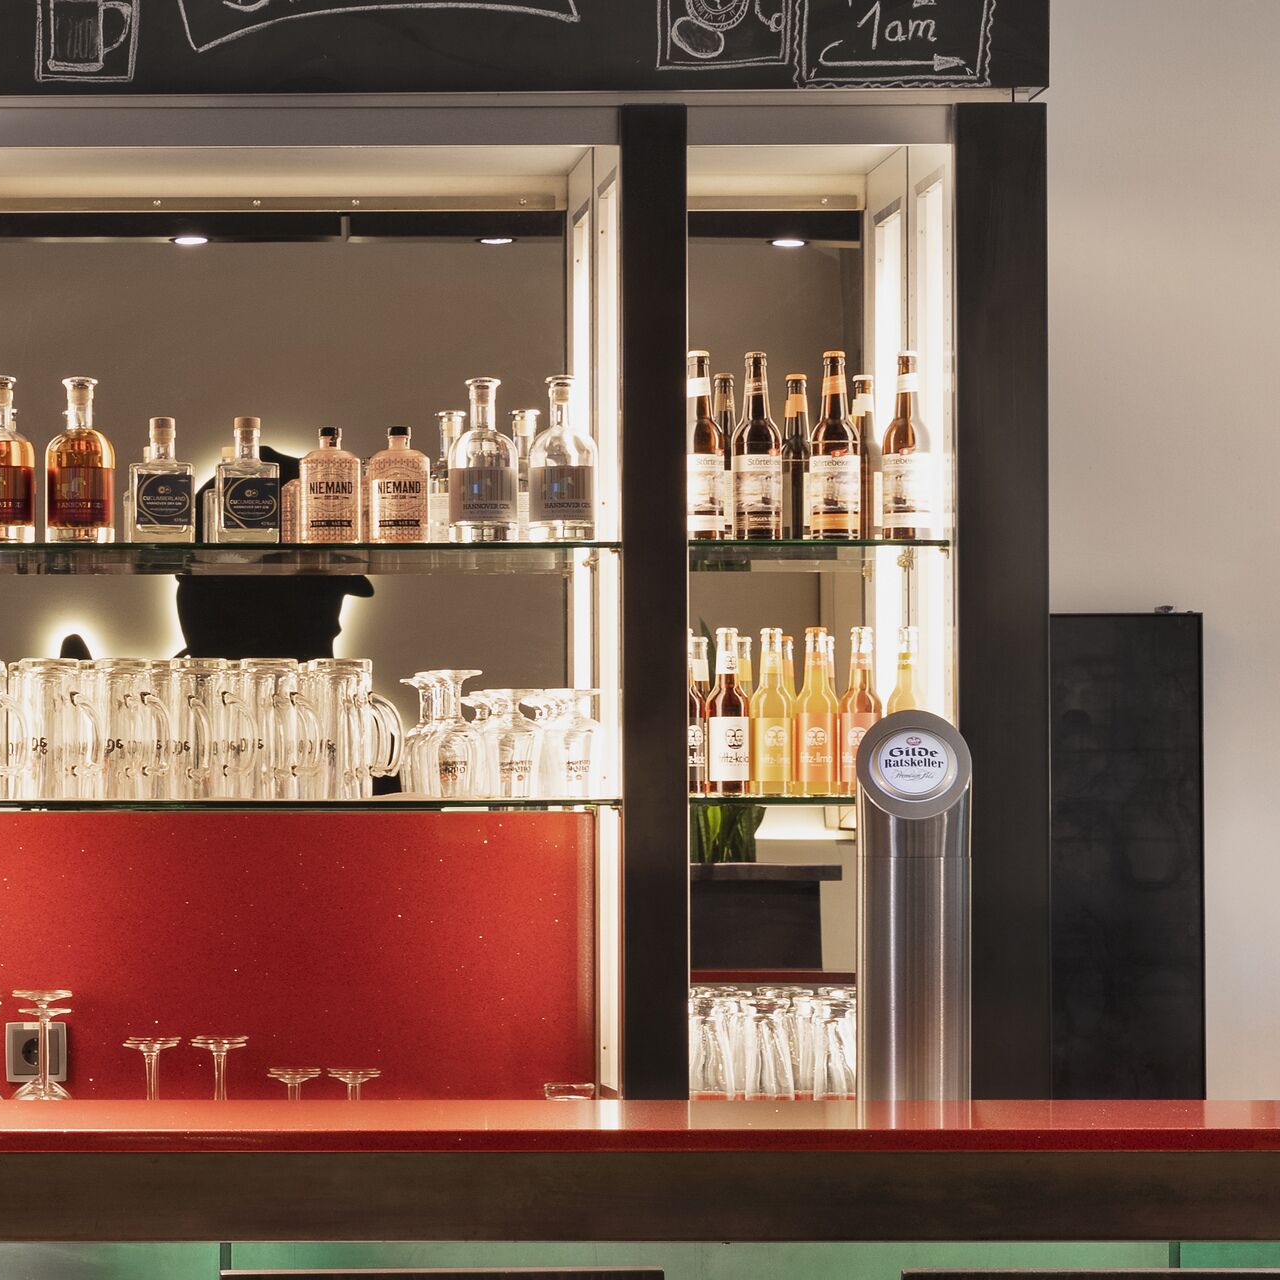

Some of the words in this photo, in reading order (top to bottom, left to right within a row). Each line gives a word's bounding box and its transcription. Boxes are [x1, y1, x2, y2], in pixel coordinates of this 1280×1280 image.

[857, 1, 938, 50] 1am
[309, 481, 353, 495] NIEMAND
[377, 480, 421, 494] NIEMAND
[889, 747, 939, 758] Gilde
[884, 758, 944, 769] Ratskeller
